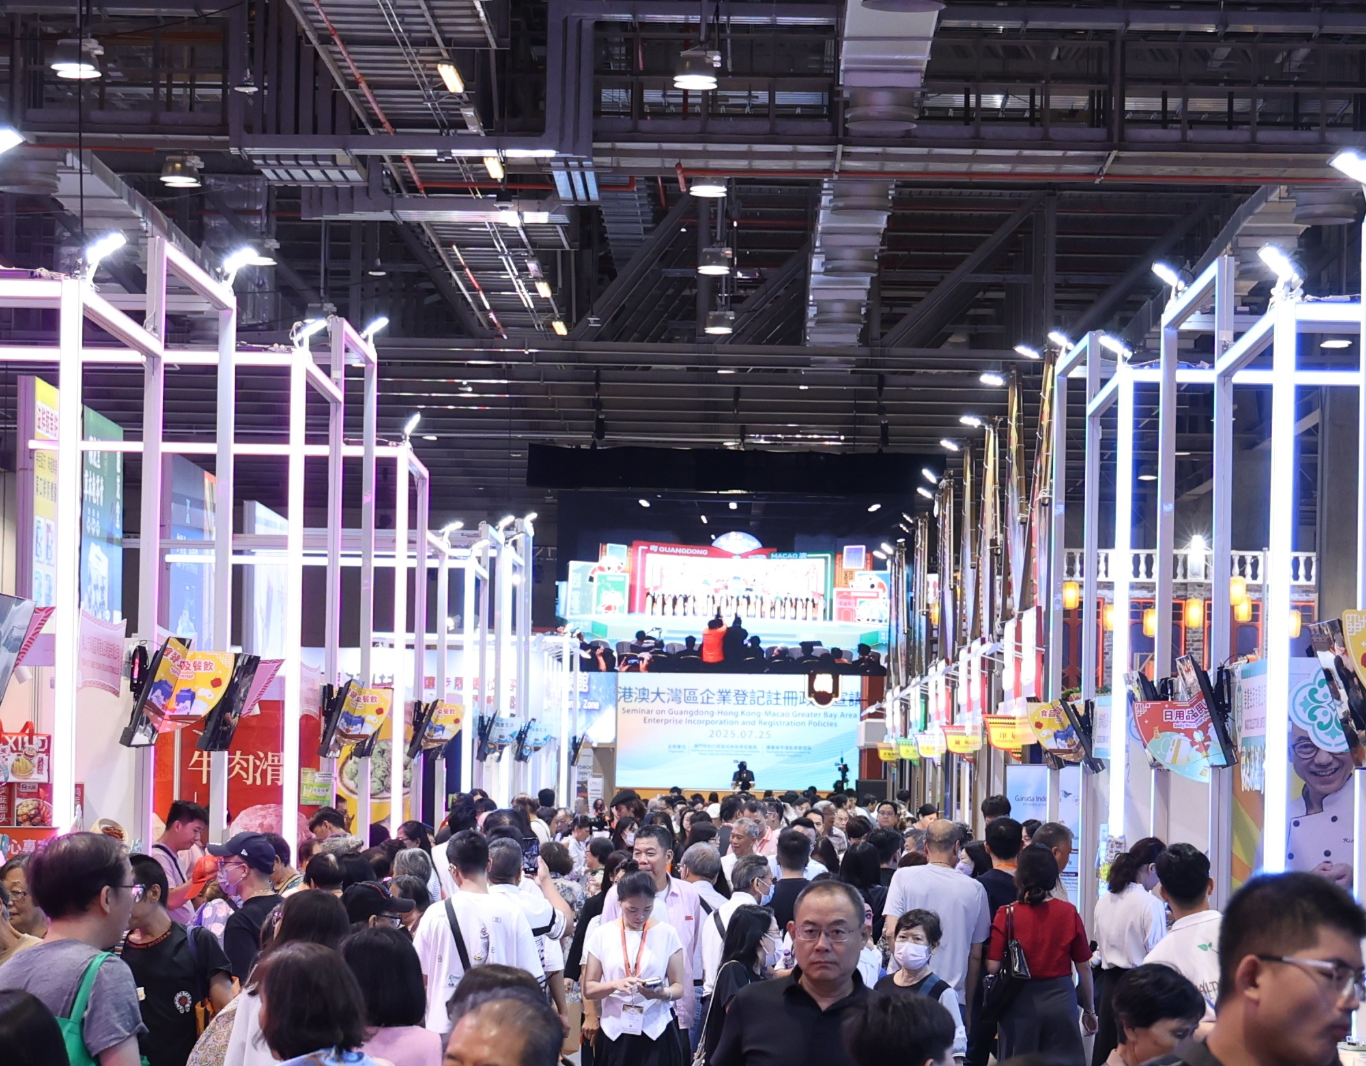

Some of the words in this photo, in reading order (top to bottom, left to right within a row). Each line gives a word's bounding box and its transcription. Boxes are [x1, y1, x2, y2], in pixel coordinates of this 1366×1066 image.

[659, 546, 709, 555] GUANGDONG
[618, 686, 861, 708] 港澳大灣區企業登記註冊政宣講
[621, 707, 654, 716] Seminar
[792, 711, 823, 719] Greater
[823, 711, 838, 720] Bay
[839, 711, 858, 719] Area
[643, 716, 684, 726] Enterprise
[684, 717, 740, 727] Incorporation
[741, 718, 756, 726] and
[758, 718, 807, 728] Registration
[808, 719, 838, 728] Policies
[708, 729, 772, 740] 2025.07.25
[1015, 795, 1035, 803] Garuda
